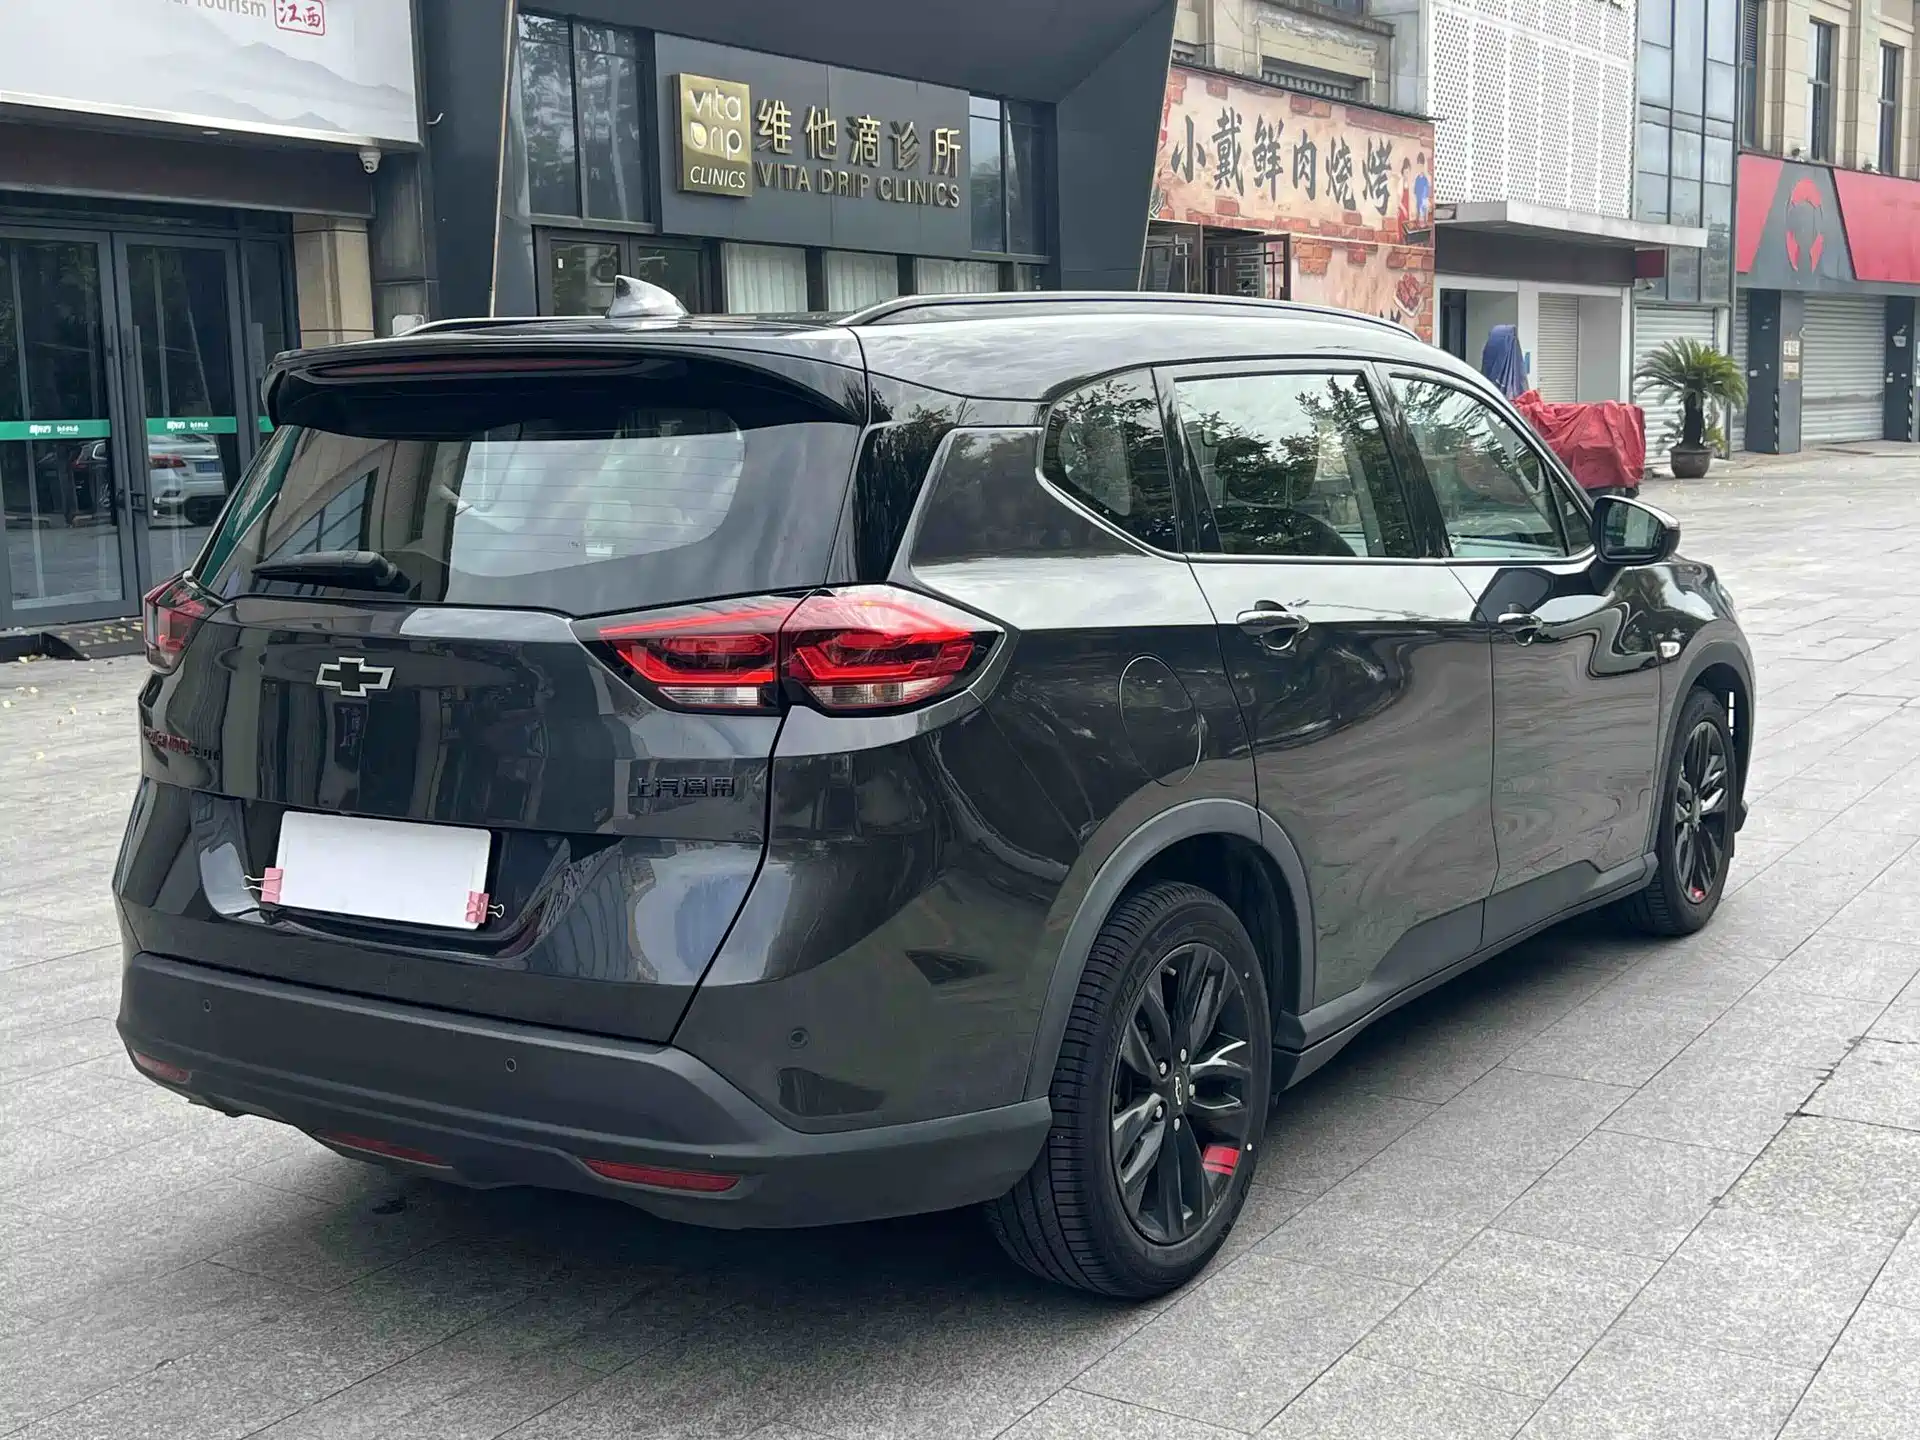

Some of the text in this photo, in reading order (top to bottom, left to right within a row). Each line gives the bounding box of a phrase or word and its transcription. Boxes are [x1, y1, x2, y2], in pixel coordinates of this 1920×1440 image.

[278, 4, 322, 28] 江西
[688, 86, 741, 120] vita
[757, 98, 962, 177] 维他滴诊所
[690, 166, 746, 188] CLINICS
[1171, 106, 1392, 216] 小戴鲜肉烧烤
[757, 160, 960, 208] VITA DRIP CLINICS
[628, 776, 736, 798] 上汽通用
